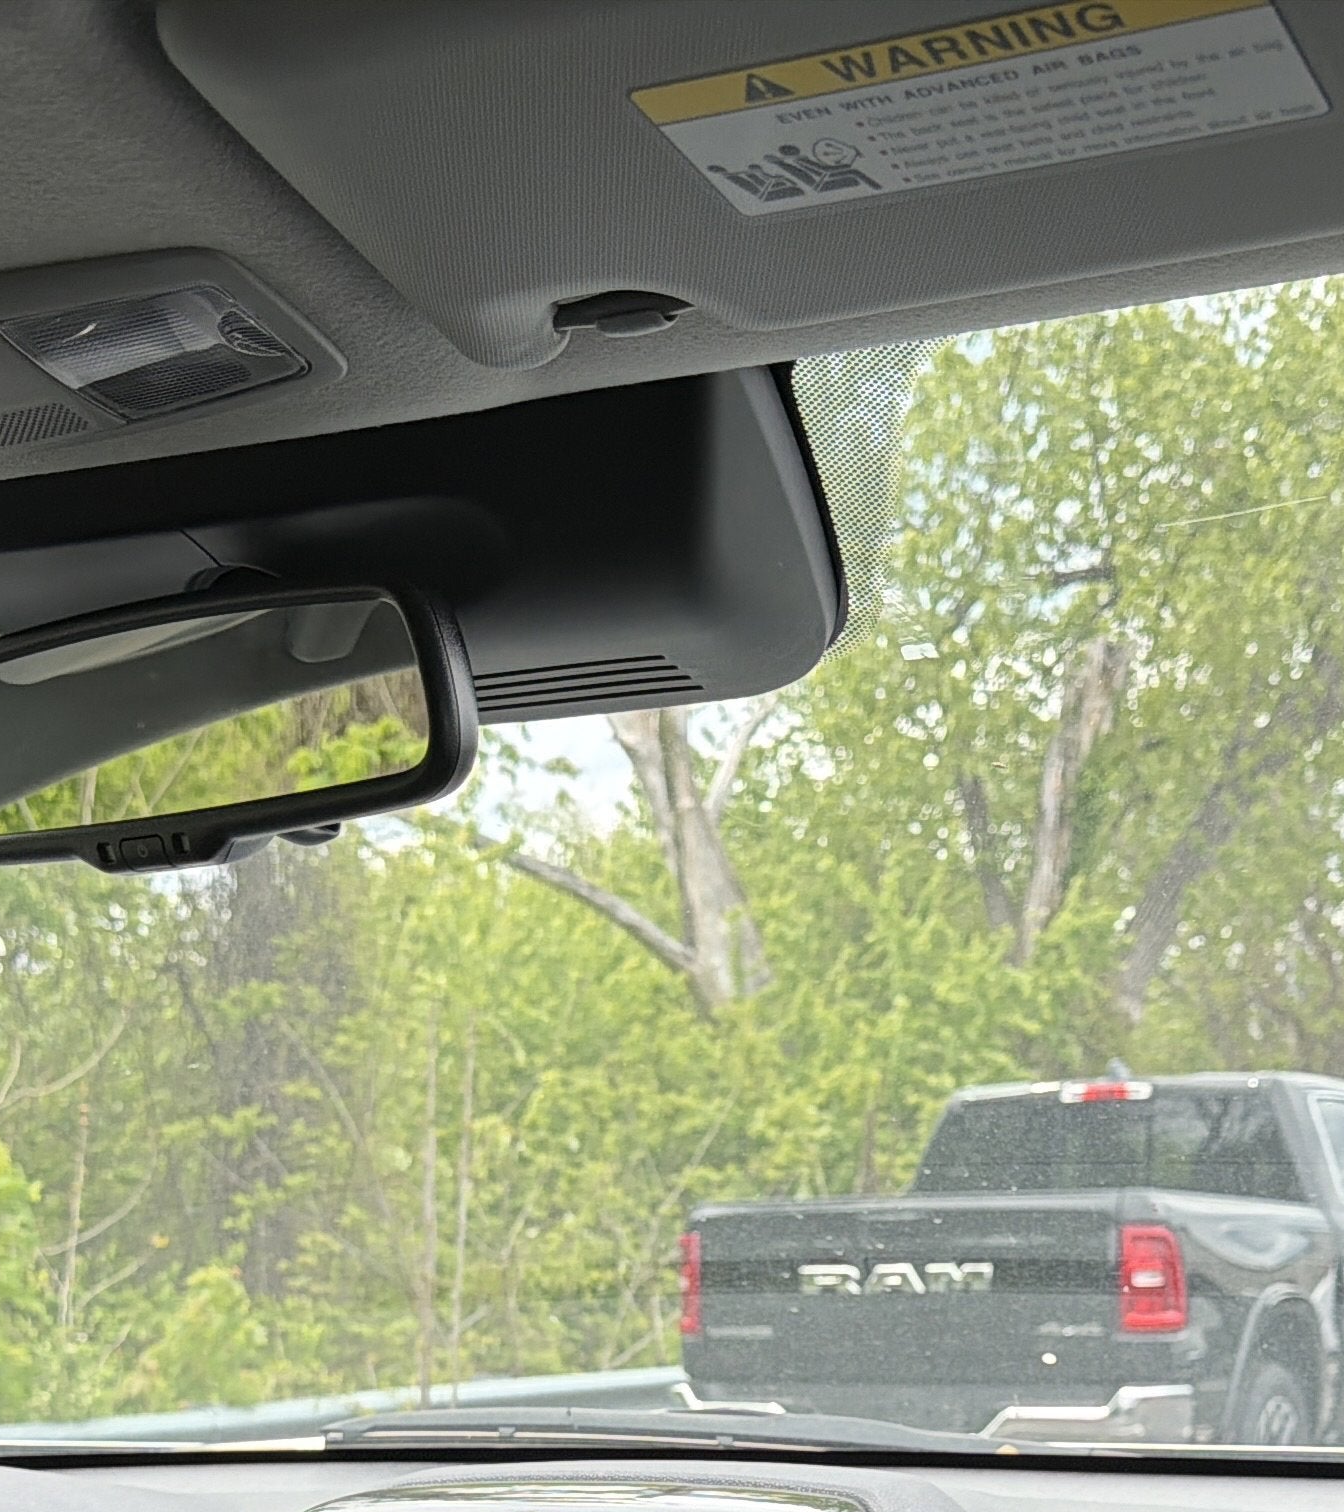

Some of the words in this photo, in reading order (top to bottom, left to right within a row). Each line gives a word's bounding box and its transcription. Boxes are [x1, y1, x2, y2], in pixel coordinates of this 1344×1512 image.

[820, 3, 1125, 83] WARNING
[775, 106, 832, 125] EVEN
[840, 94, 893, 112] WITH
[904, 70, 1020, 100] ADVANCED
[1032, 59, 1068, 77] AIR
[1077, 45, 1142, 66] BAGS
[797, 1262, 995, 1295] RAM
